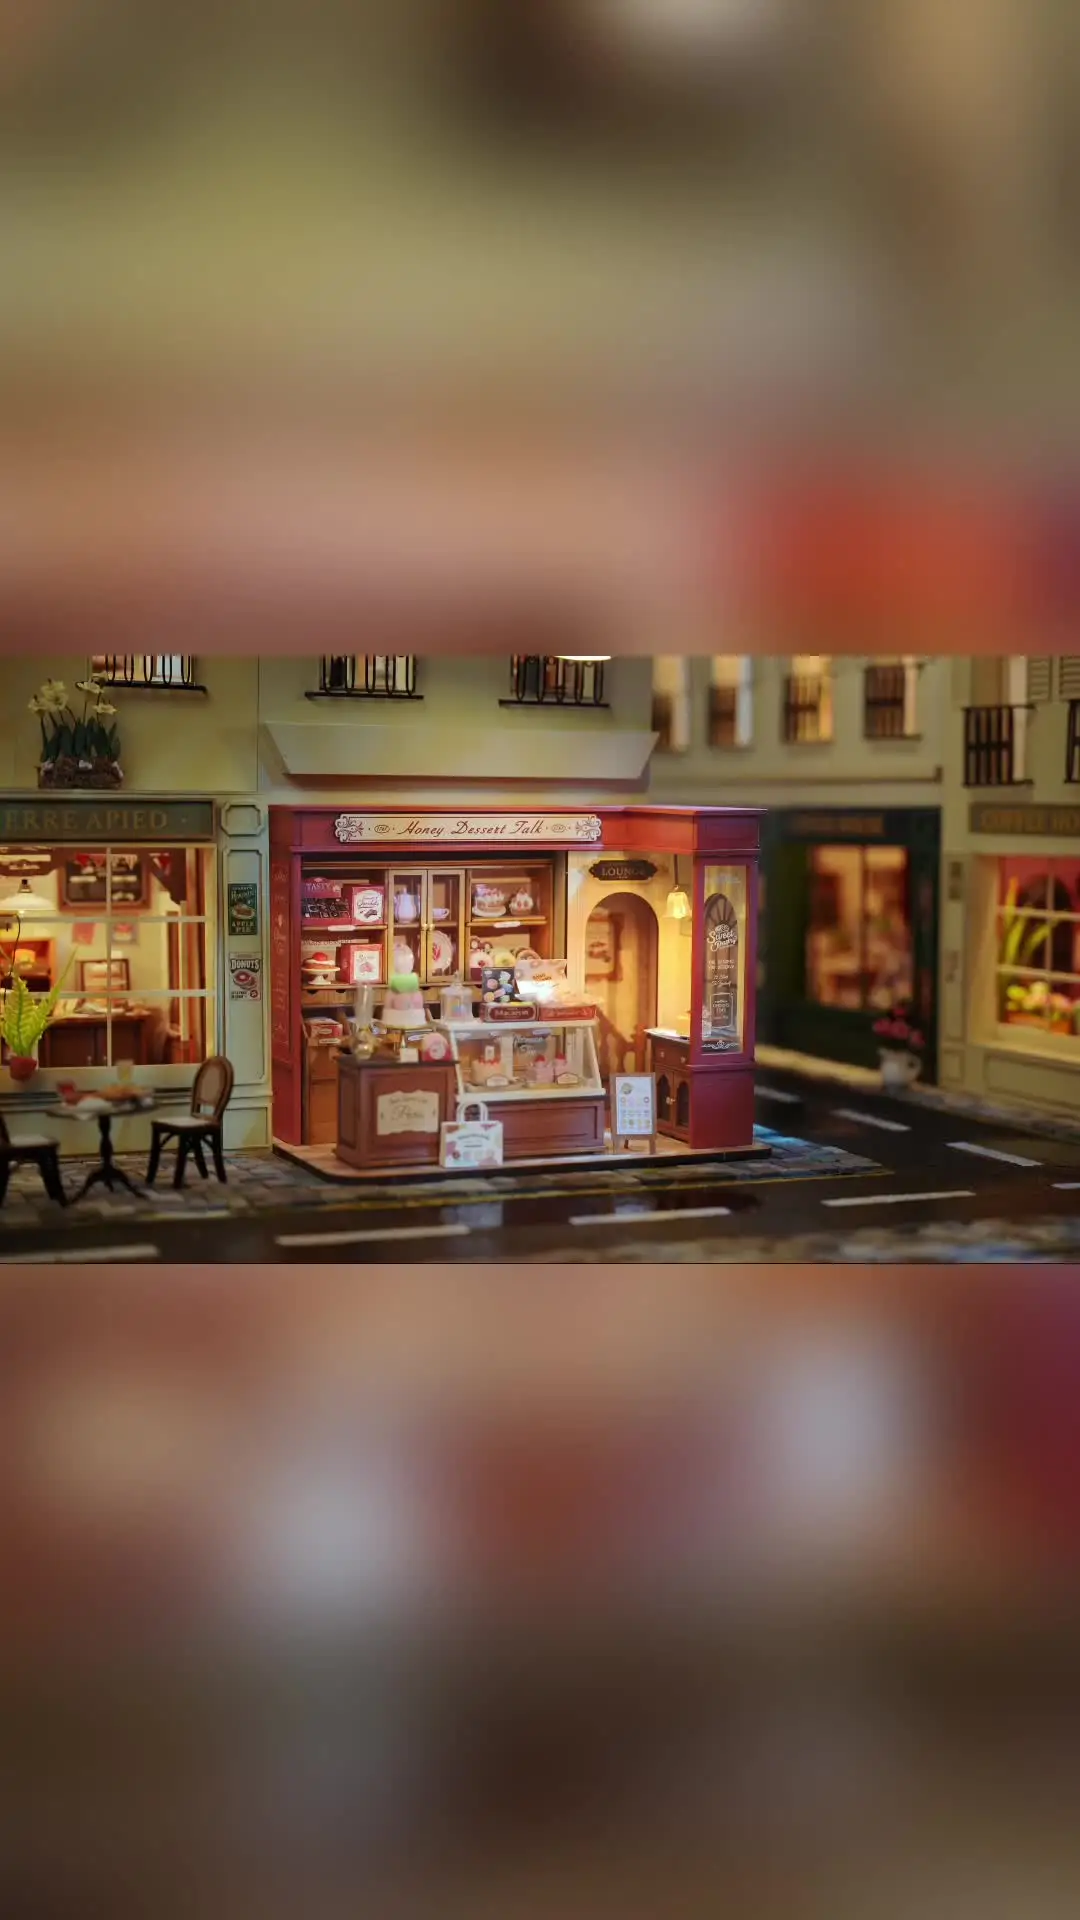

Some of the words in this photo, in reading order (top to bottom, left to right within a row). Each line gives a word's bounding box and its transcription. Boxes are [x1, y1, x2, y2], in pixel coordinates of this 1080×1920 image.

[397, 820, 445, 837] Honey
[450, 820, 506, 835] Dessert
[509, 820, 544, 834] Talk
[231, 959, 260, 970] DONUTS
